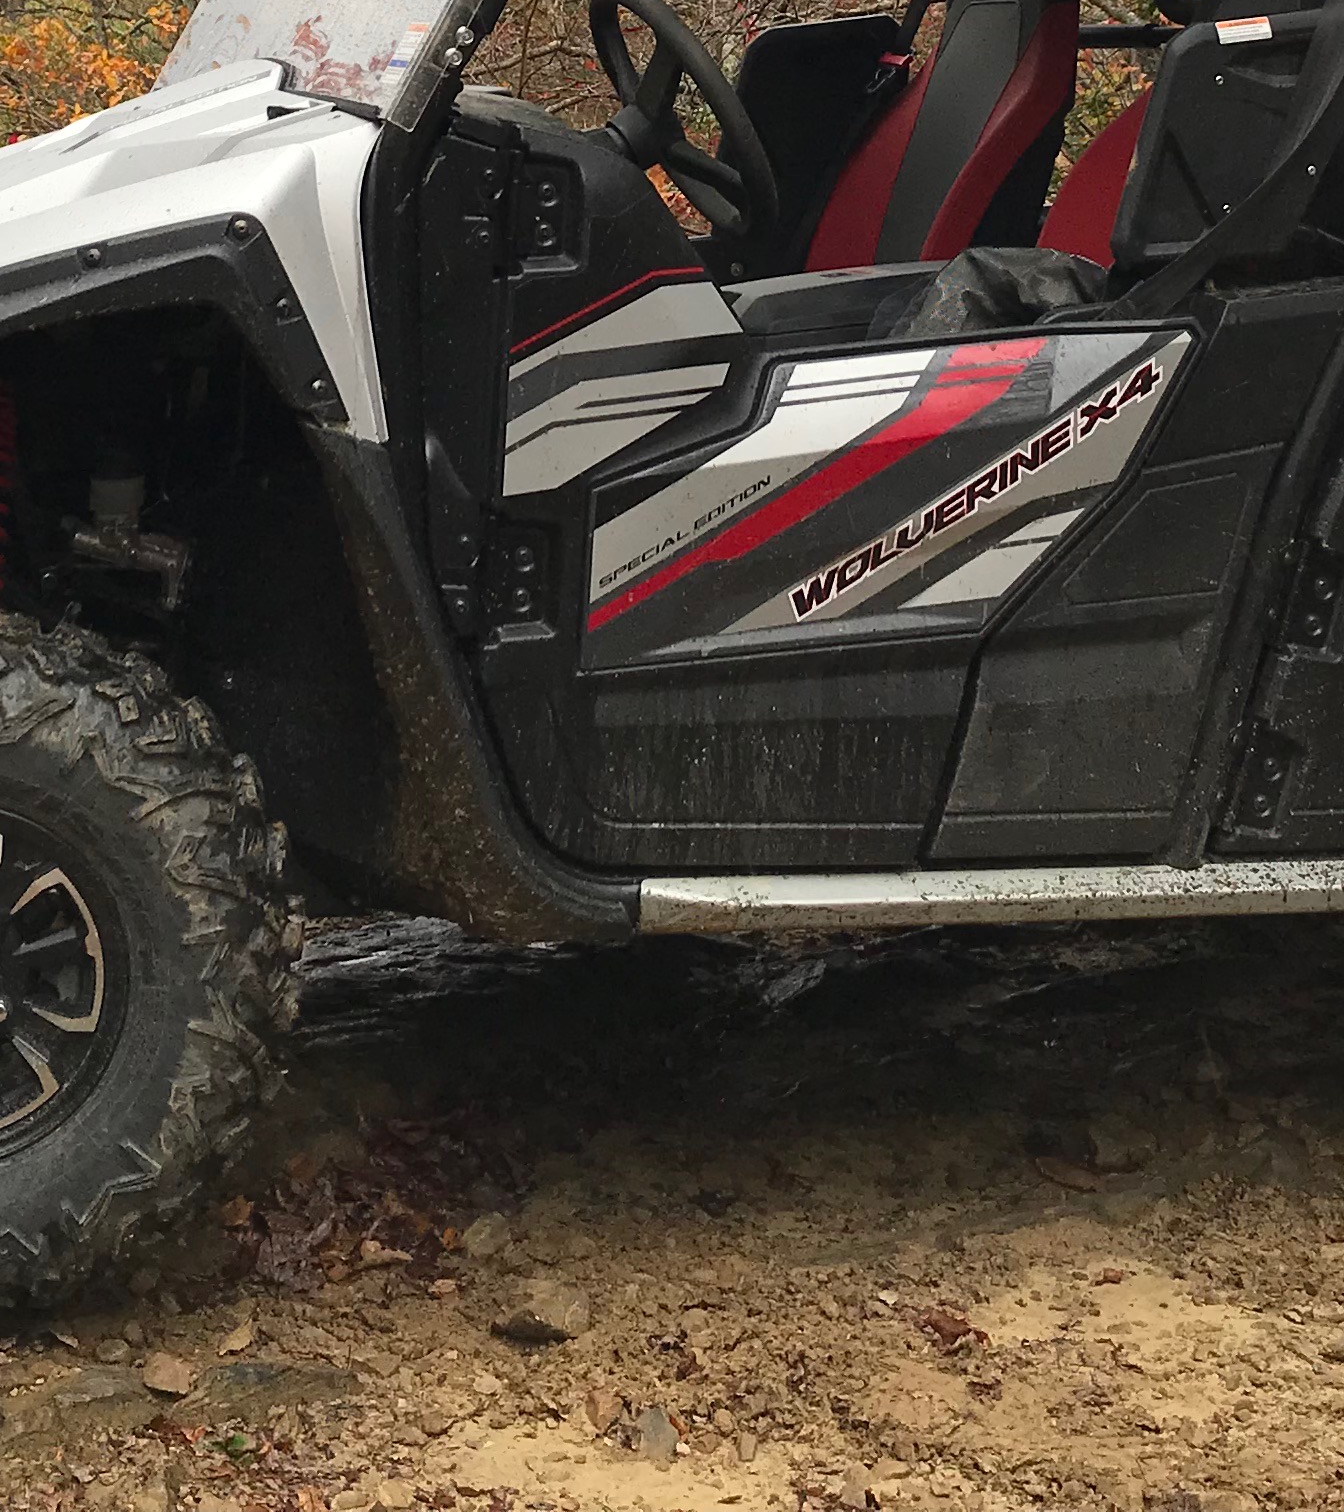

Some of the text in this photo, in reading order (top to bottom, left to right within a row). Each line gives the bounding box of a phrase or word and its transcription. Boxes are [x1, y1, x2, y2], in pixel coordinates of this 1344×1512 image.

[599, 475, 771, 588] SPECIAL EDITION
[789, 358, 1162, 621] WOLVERINE X4
